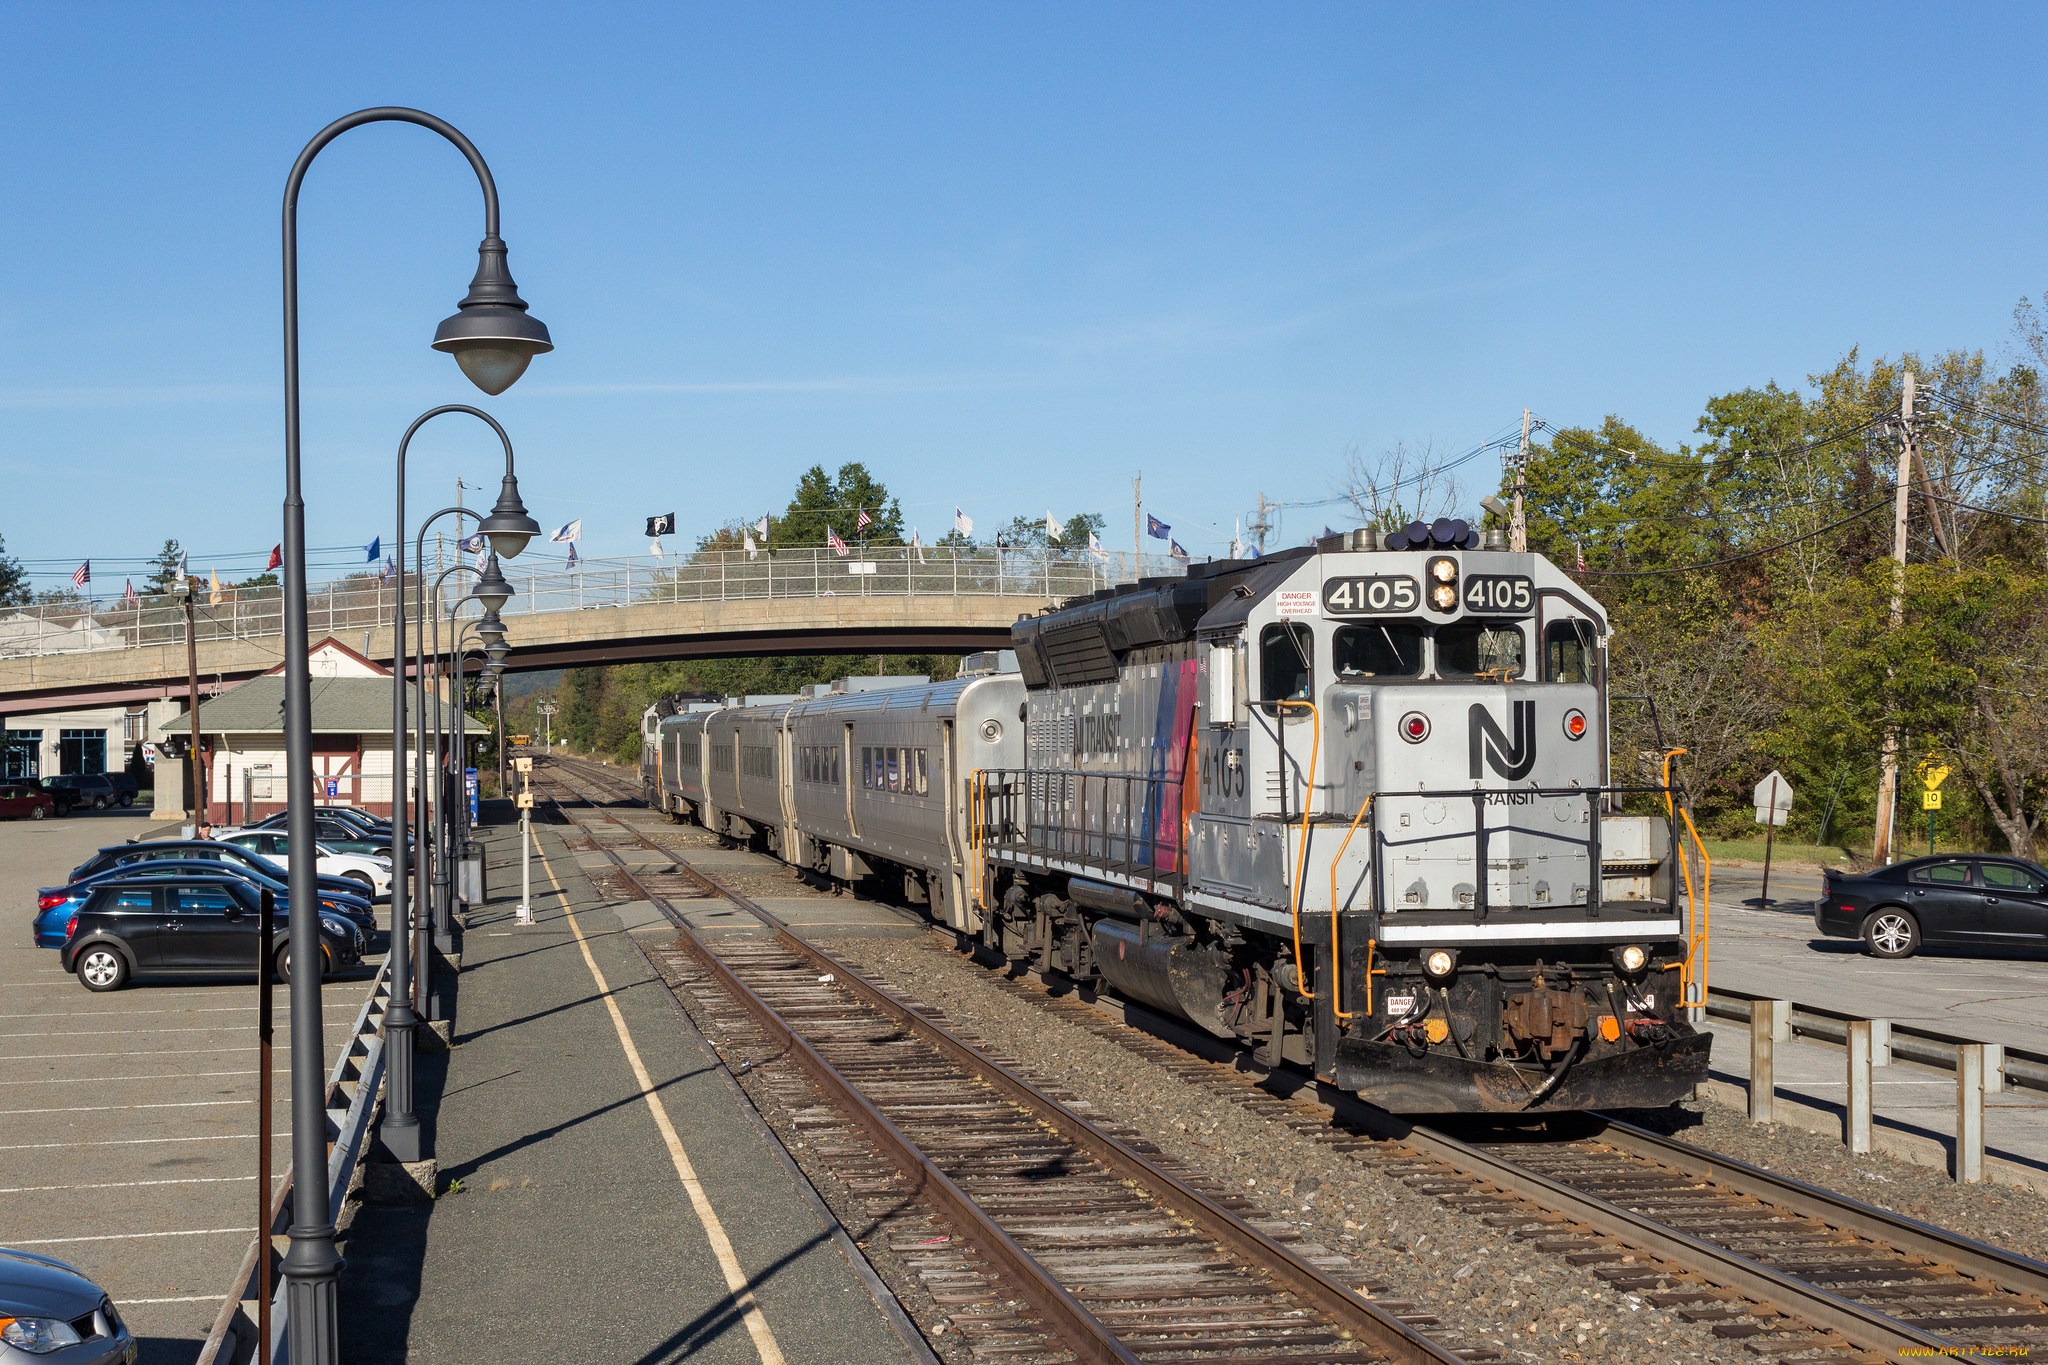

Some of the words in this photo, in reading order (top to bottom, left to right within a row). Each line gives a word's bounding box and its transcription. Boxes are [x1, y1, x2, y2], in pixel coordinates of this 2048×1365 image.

[1281, 592, 1312, 600] DANGER
[1329, 580, 1415, 609] 4105
[1467, 579, 1531, 608] 4105
[1085, 714, 1121, 753] TRANSIT
[1468, 700, 1537, 781] NJ
[1203, 748, 1245, 798] 4105
[1926, 793, 1938, 802] 10
